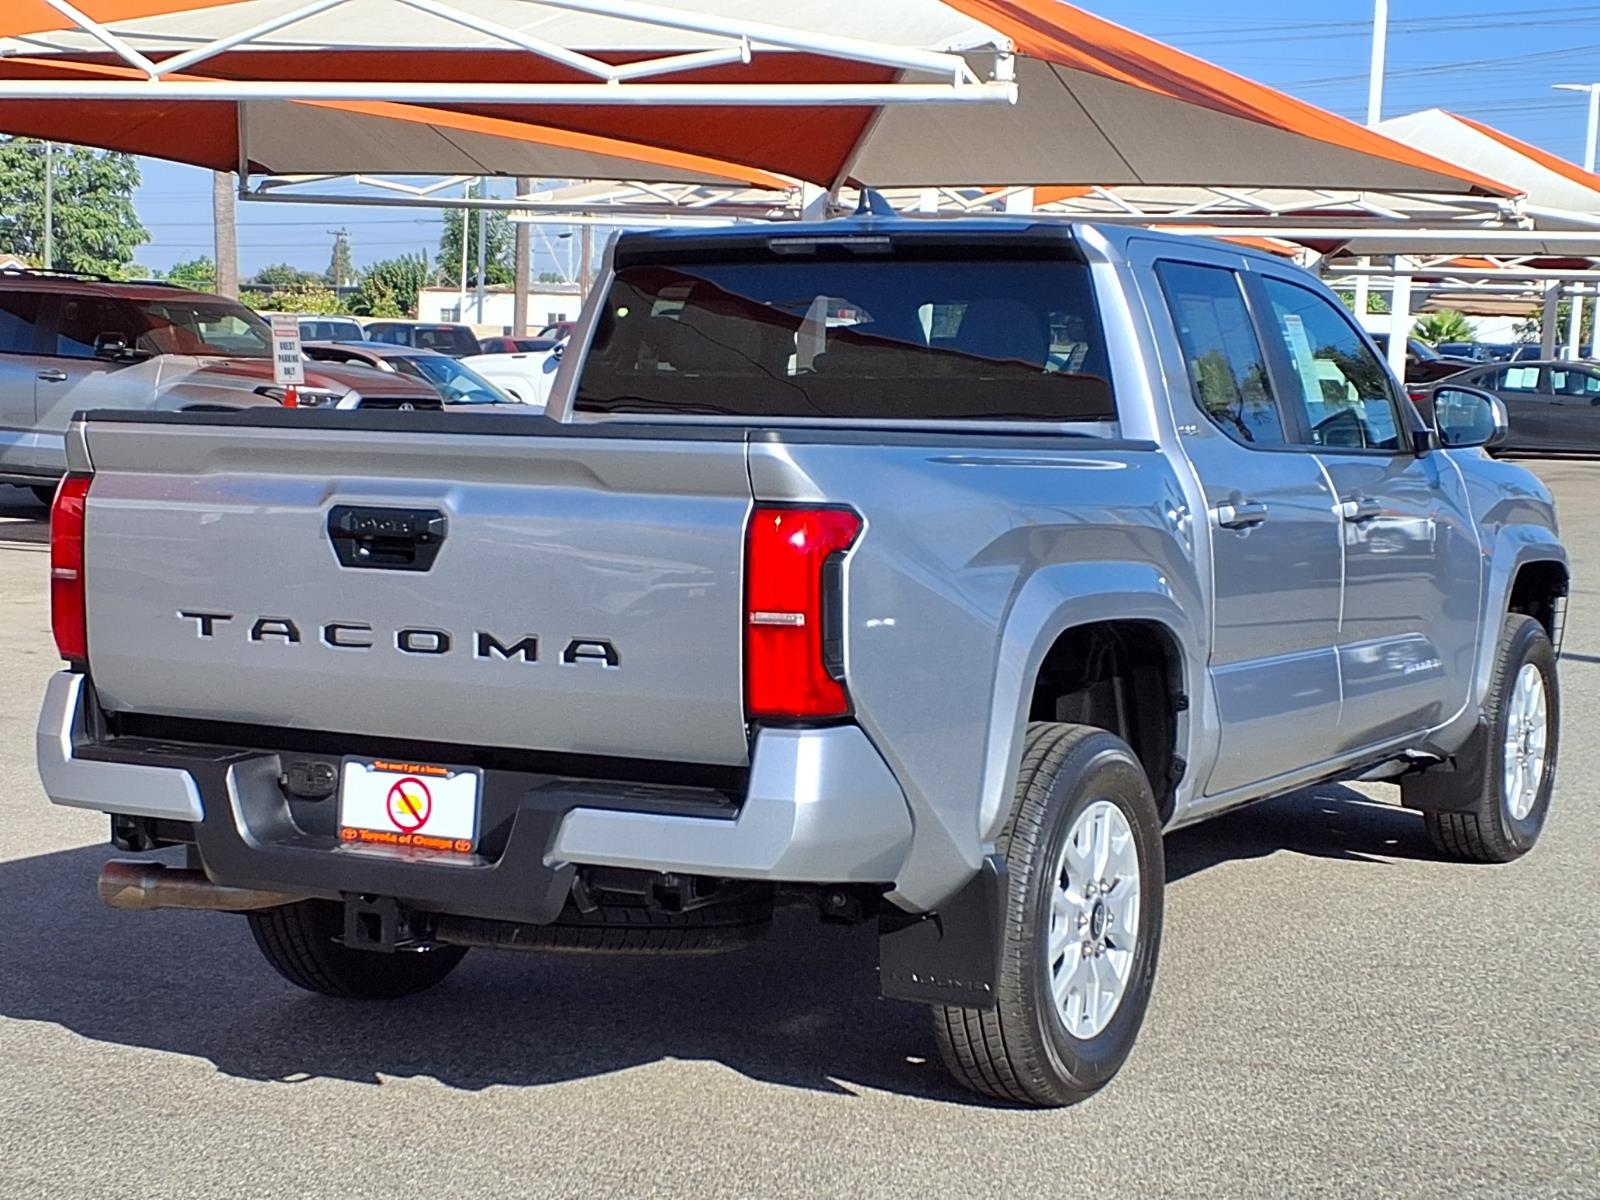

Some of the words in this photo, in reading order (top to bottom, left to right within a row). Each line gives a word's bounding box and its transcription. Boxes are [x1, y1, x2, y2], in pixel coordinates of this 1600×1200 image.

[278, 354, 299, 363] PARKING
[176, 608, 621, 670] TACOMA
[359, 829, 398, 844] Toyota
[398, 834, 412, 844] of
[412, 835, 453, 850] Orange
